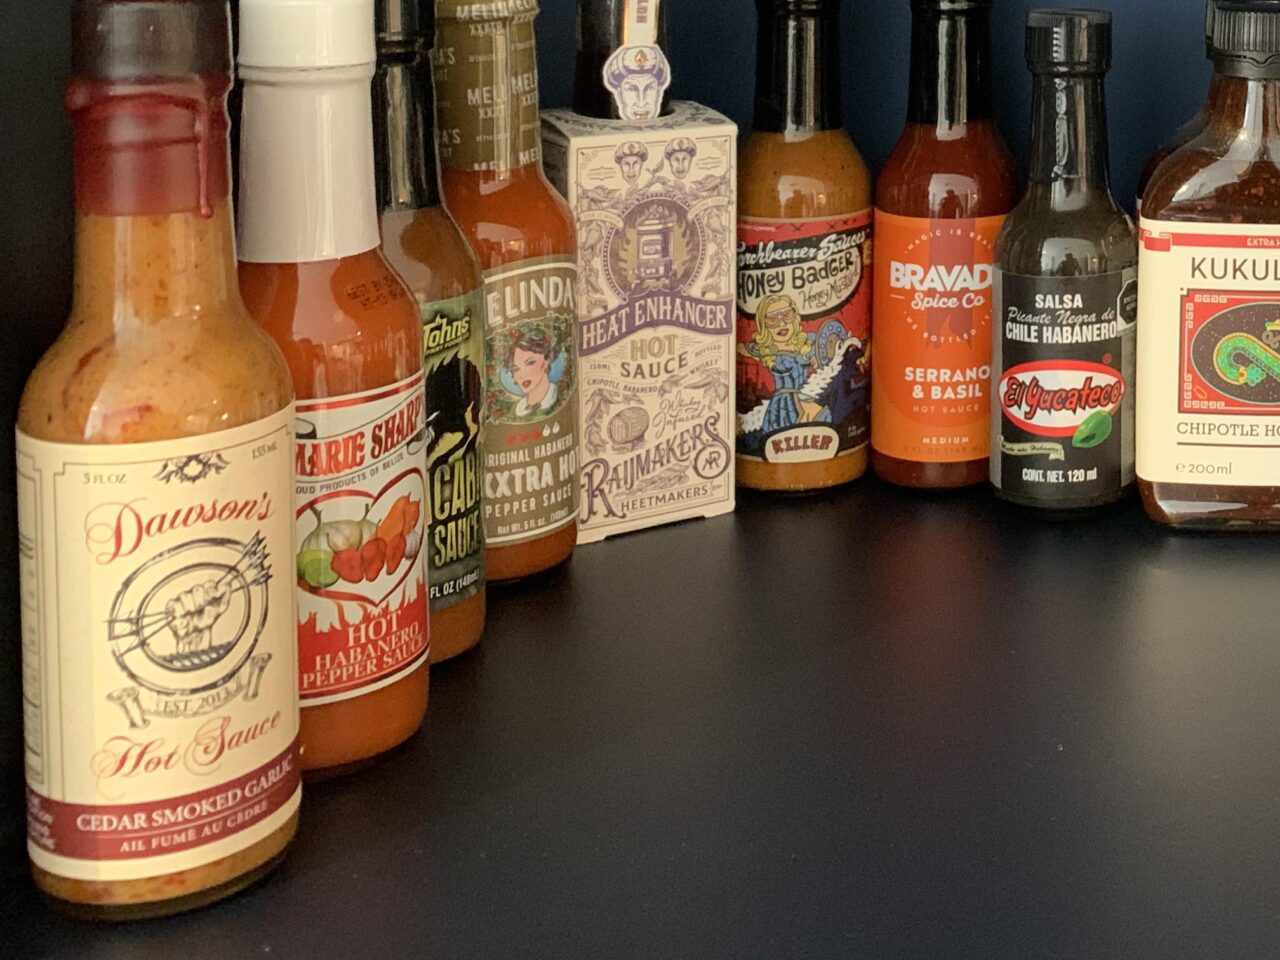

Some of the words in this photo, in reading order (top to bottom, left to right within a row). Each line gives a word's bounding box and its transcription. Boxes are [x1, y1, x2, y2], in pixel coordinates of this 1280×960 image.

[817, 227, 866, 262] Sauces
[906, 228, 942, 252] MAGIC
[949, 227, 962, 236] IS
[1246, 238, 1276, 247] EXTRA
[889, 260, 994, 293] BRAVAD
[486, 275, 574, 327] ELINDA
[911, 291, 960, 312] Spice
[961, 291, 986, 309] Co
[1034, 293, 1083, 309] SALSA
[582, 307, 631, 350] HEAT
[633, 295, 728, 330] ENHANCER
[1007, 306, 1052, 325] Picante
[1055, 309, 1097, 328] Negra
[1101, 307, 1116, 321] de
[1005, 321, 1040, 343] CHILE
[1042, 321, 1118, 344] HABANERO
[630, 333, 679, 362] HOT
[620, 350, 690, 380] SAUCE
[690, 358, 719, 376] WHISKEY
[904, 365, 991, 383] SERRANO
[587, 378, 621, 391] CHIPOTLE
[911, 384, 925, 400] &
[930, 383, 983, 400] BASIL
[1003, 376, 1027, 410] El
[1023, 375, 1122, 421] Yucateco
[912, 405, 936, 414] HOT
[942, 403, 979, 414] SAUCE
[922, 436, 970, 445] MEDIUM
[1176, 421, 1260, 438] CHIPOTLE
[533, 434, 573, 460] HABANERO
[770, 433, 834, 455] KILLER
[295, 485, 316, 495] OUD
[319, 474, 368, 493] PRODUCTS
[369, 466, 380, 477] OF
[579, 411, 731, 525] RAIJMAKERS
[1022, 467, 1045, 483] CONT.
[1046, 470, 1065, 483] NET.
[1067, 468, 1085, 482] 120
[1086, 466, 1097, 480] ml
[486, 497, 537, 518] PEPPER
[542, 483, 572, 507] SAUCE
[620, 485, 709, 513] HEETMAKERS
[83, 490, 274, 567] Dawson's
[433, 509, 480, 569] SAUCE
[429, 584, 440, 599] FL
[442, 580, 455, 594] OZ
[347, 610, 402, 648] HOT
[302, 658, 378, 689] PEPPER
[382, 630, 424, 669] SAUCE
[315, 621, 420, 673] HABANERO
[90, 735, 183, 780] Hot
[183, 709, 281, 778] Sauce
[75, 811, 150, 833] CEDAR
[150, 786, 244, 826] SMOKED
[244, 752, 294, 799] GARLIC
[119, 838, 147, 854] AIL
[200, 819, 224, 838] AU
